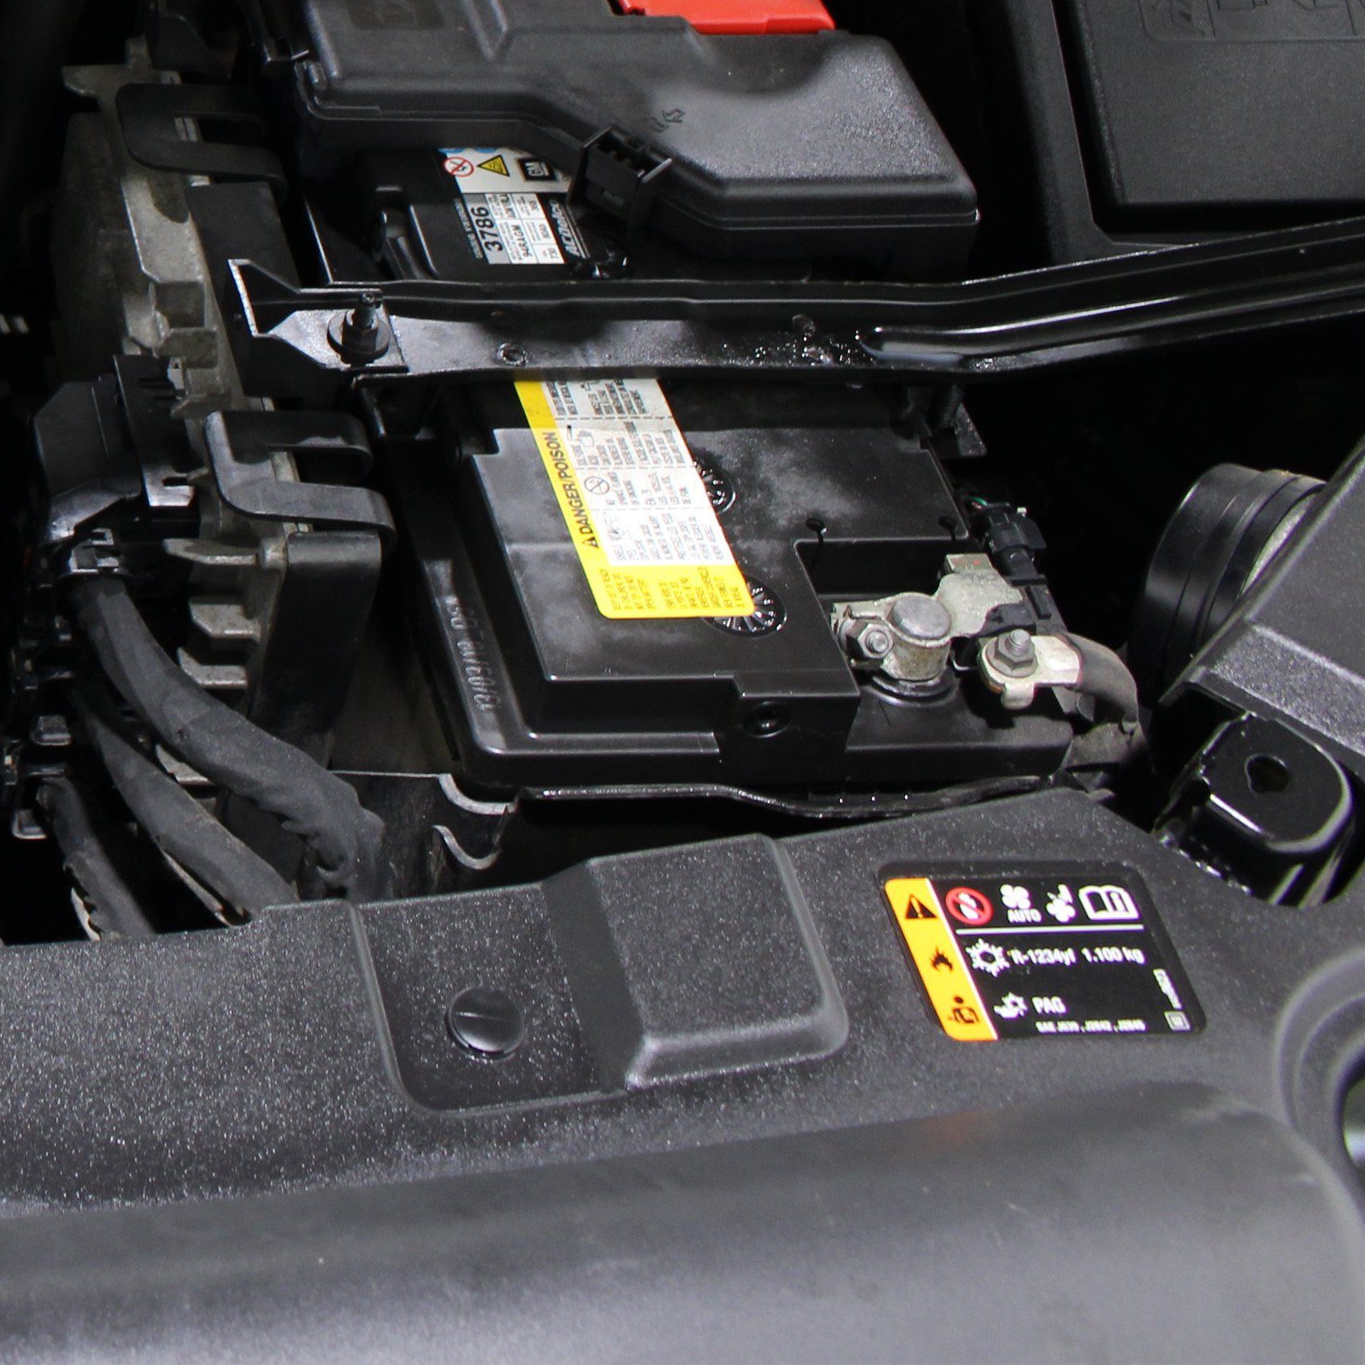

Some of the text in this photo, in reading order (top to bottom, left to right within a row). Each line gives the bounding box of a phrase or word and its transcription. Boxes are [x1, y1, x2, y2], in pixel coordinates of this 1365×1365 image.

[470, 206, 503, 252] 3786
[1007, 907, 1042, 923] AUTO
[1032, 995, 1067, 1015] PAG
